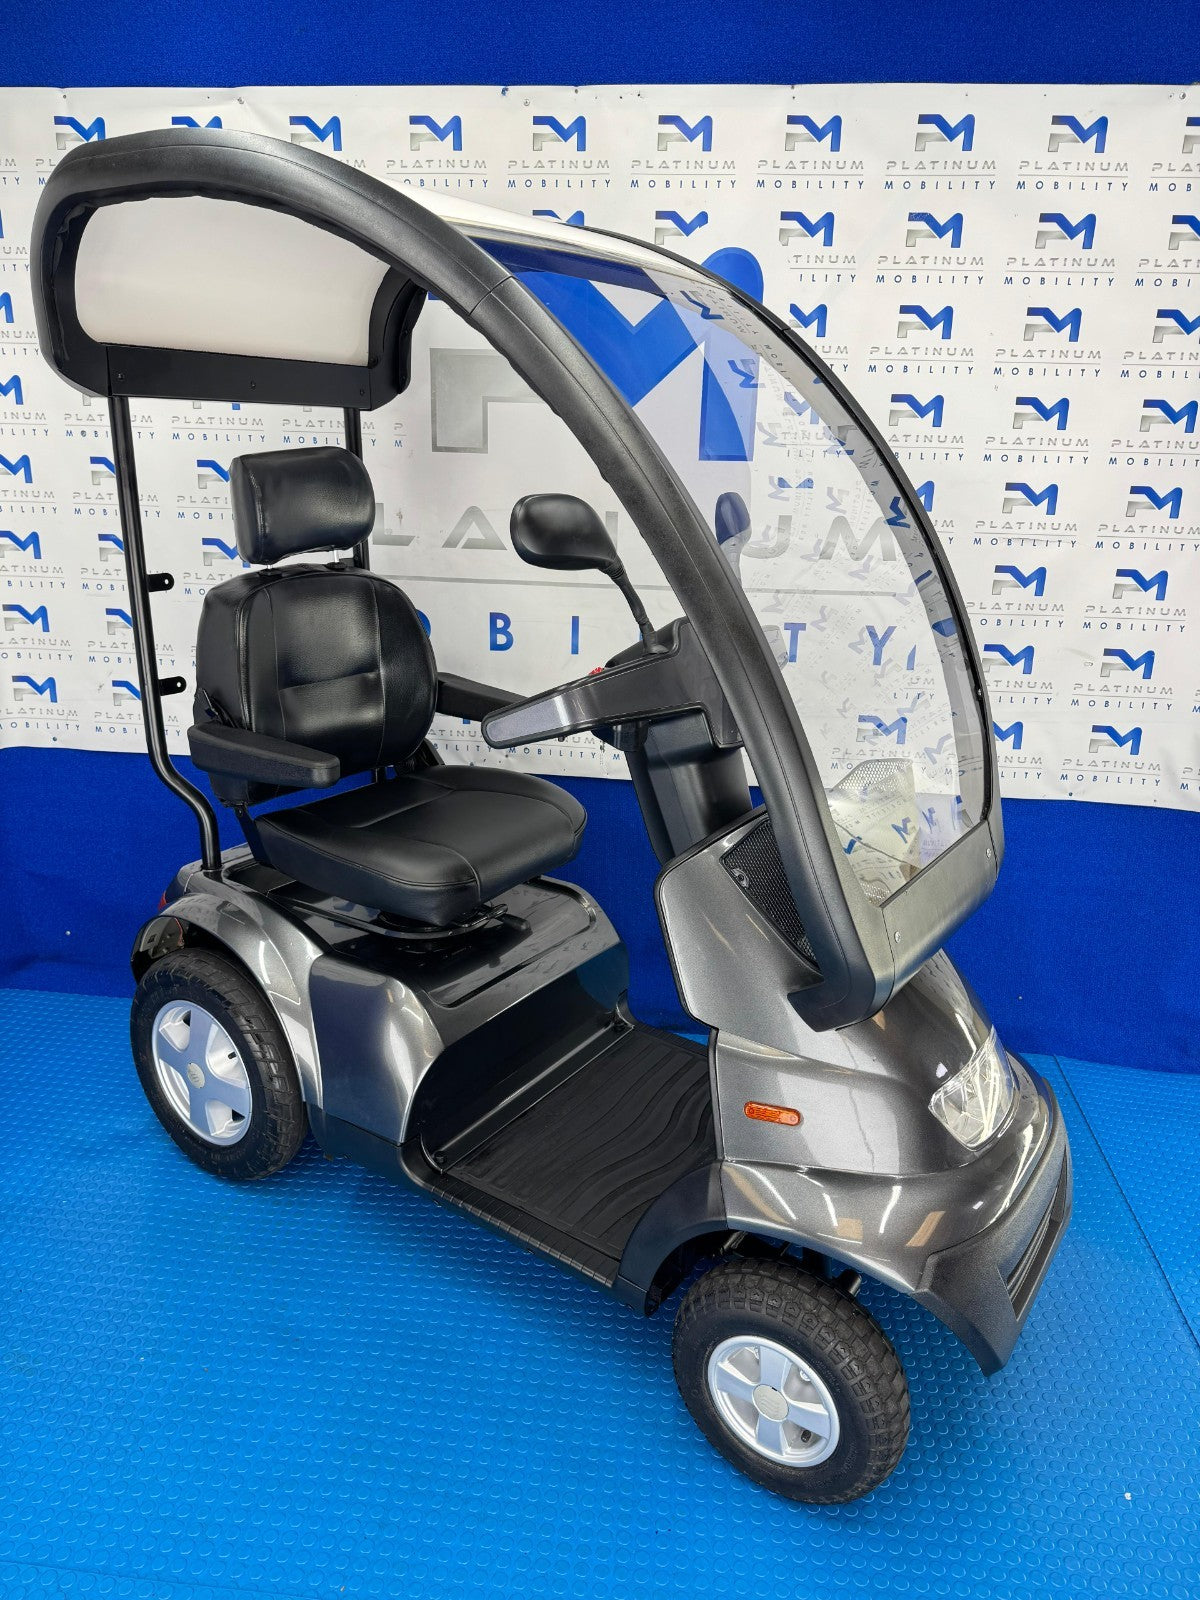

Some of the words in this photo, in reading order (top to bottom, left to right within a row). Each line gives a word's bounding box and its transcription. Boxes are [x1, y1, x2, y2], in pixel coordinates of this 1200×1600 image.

[386, 159, 487, 169] PLATINUM
[508, 160, 610, 169] PLATINUM
[631, 160, 736, 169] PLATINUM
[757, 160, 864, 170] PLATINUM
[886, 161, 996, 170] PLATINUM
[1019, 161, 1128, 171] PLATINUM
[508, 179, 611, 188] MOBILITY
[631, 179, 736, 188] MOBILITY
[757, 179, 864, 189] MOBILITY
[885, 181, 995, 190] MOBILITY
[1017, 181, 1128, 191] MOBILITY
[789, 254, 856, 264] TINUM
[878, 256, 984, 266] PLATINUM
[1007, 258, 1115, 267] PLATINUM
[799, 274, 856, 283] ILITY
[876, 275, 983, 284] MOBILITY
[1004, 277, 1114, 287] MOBILITY
[1135, 278, 1191, 288] MOBI
[870, 346, 973, 356] PLATINUM
[995, 349, 1101, 358] PLATINUM
[1123, 351, 1200, 360] PLATIN
[868, 365, 973, 374] MOBILITY
[994, 367, 1100, 377] MOBILITY
[1120, 370, 1199, 379] MOBIL
[171, 416, 264, 426] PLATINUM
[66, 430, 154, 438] MOBITY
[172, 432, 265, 442] MOBILITY
[889, 434, 964, 443] ATINUM
[283, 435, 376, 446] MOBILY
[985, 437, 1088, 446] PLATINUM
[1111, 439, 1200, 449] PLATINU
[983, 454, 1088, 464] MOBILITY
[1109, 457, 1200, 467] MOBILIT
[177, 495, 229, 504] PLATI
[74, 508, 161, 518] MOBITY
[975, 521, 1078, 532] PLATINUM
[973, 537, 1077, 548] MOBILITY
[1095, 541, 1199, 552] MOBILITY
[0, 565, 64, 574] ATINUM
[8, 580, 66, 589] BILITY
[1085, 605, 1187, 617] PLATINUM
[980, 618, 1064, 628] OBILITY
[1082, 621, 1185, 633] MOBILITY
[2, 652, 73, 661] OBILITY
[89, 656, 175, 666] MOBITY
[1073, 683, 1174, 695] PLATINUM
[999, 696, 1053, 705] ILITY
[1070, 699, 1173, 711] MOBILITY
[95, 726, 181, 736] MOBITY
[1063, 758, 1161, 771] PLATINUM
[1060, 774, 1161, 786] MOBILITY
